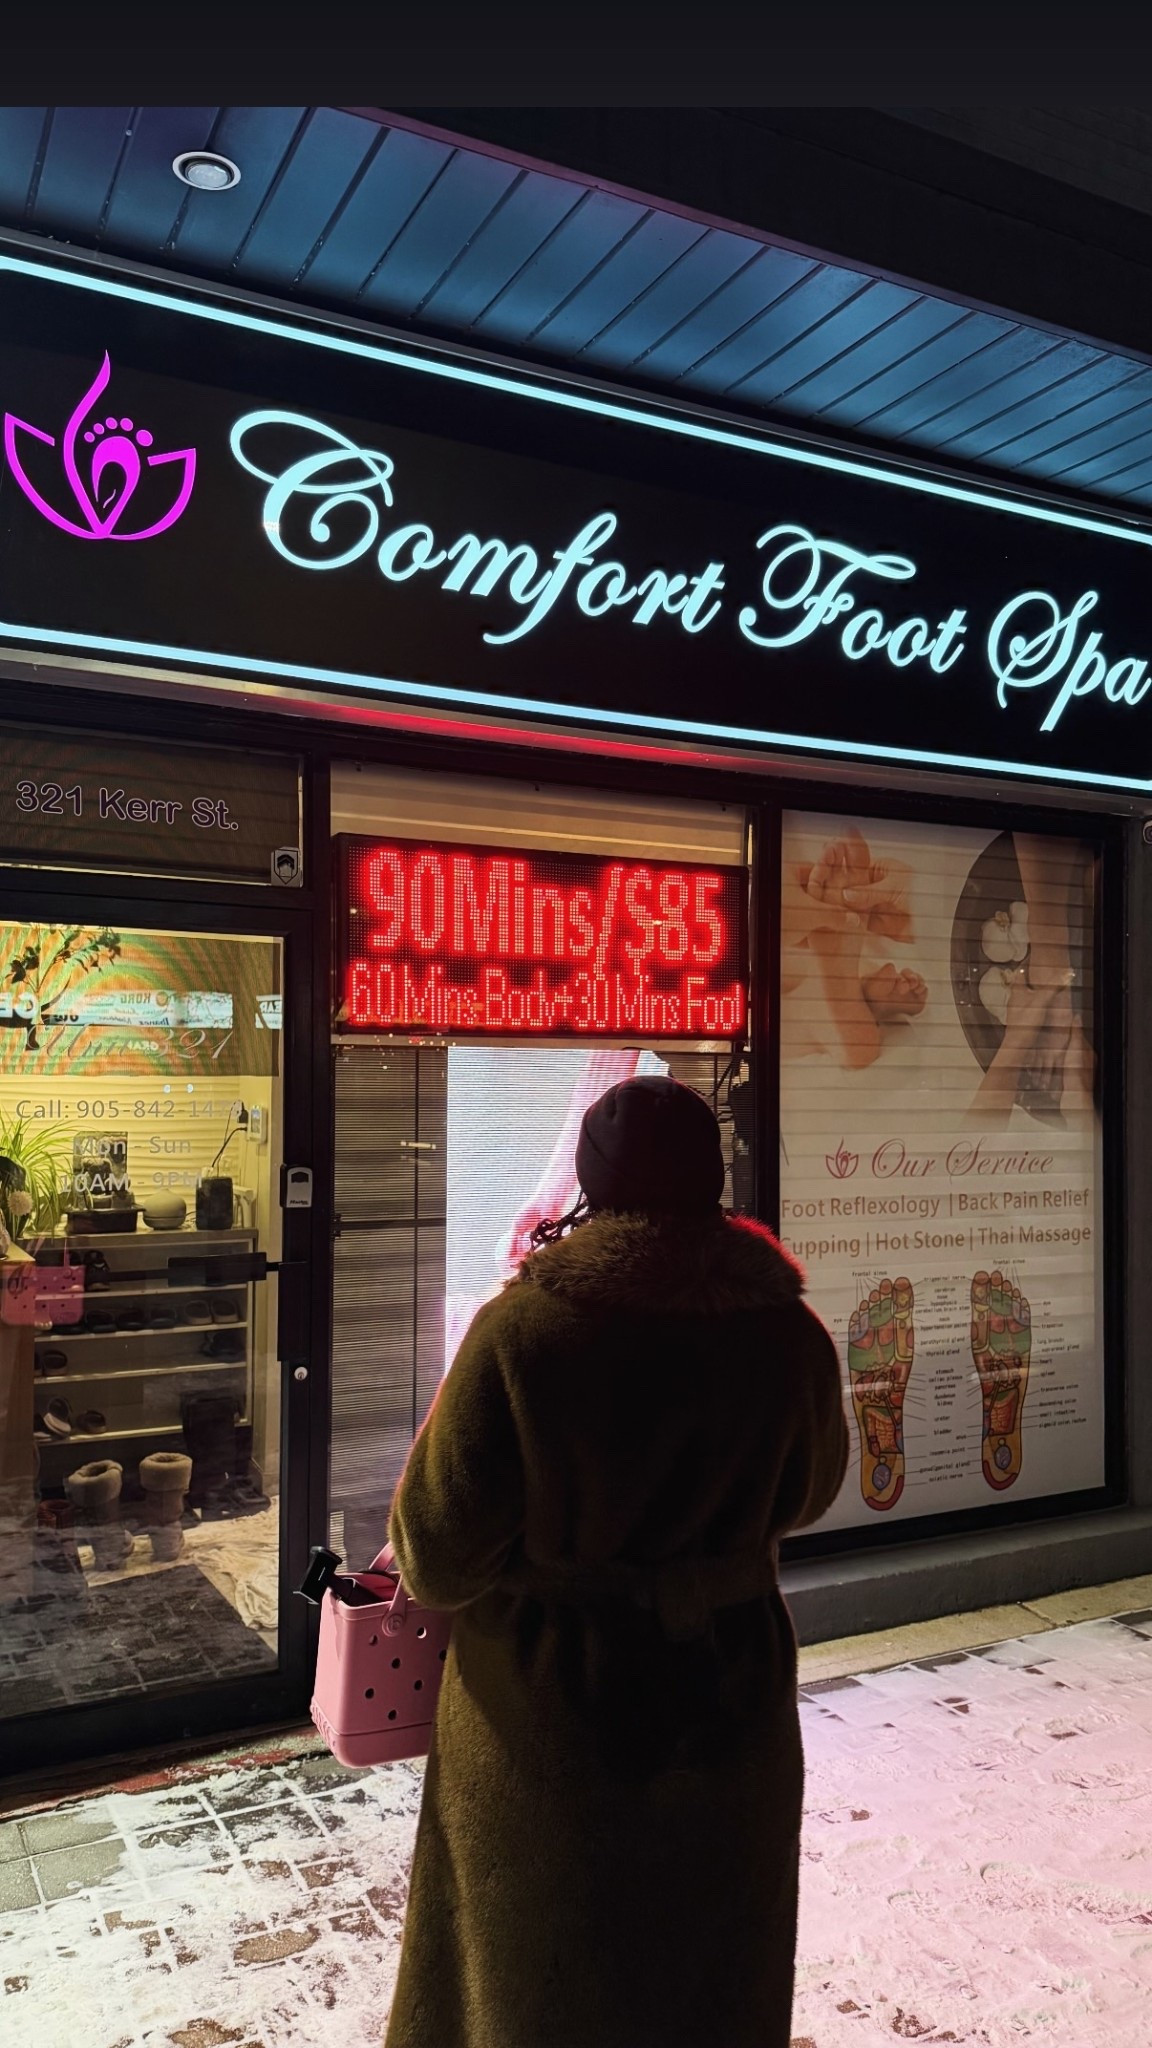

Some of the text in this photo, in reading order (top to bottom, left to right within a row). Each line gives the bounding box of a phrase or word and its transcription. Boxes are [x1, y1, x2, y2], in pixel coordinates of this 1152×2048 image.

[229, 409, 1152, 732] Comfort Foot Spa
[16, 780, 239, 832] 321 Kerr St.
[16, 1099, 69, 1119] Call:
[74, 1137, 125, 1155] Mon
[149, 1135, 191, 1154] Sun
[872, 1136, 1054, 1185] Our Service
[60, 1173, 129, 1193] 10AM
[153, 1171, 202, 1188] 9PM
[781, 1199, 825, 1218] Foot
[831, 1194, 940, 1218] Reflexology
[958, 1191, 998, 1212] Back
[1003, 1190, 1038, 1210] Pain
[1043, 1188, 1089, 1208] Relief
[876, 1231, 909, 1251] Hot
[914, 1230, 965, 1250] Stone
[977, 1226, 1014, 1246] Thai
[1019, 1224, 1091, 1245] Massage
